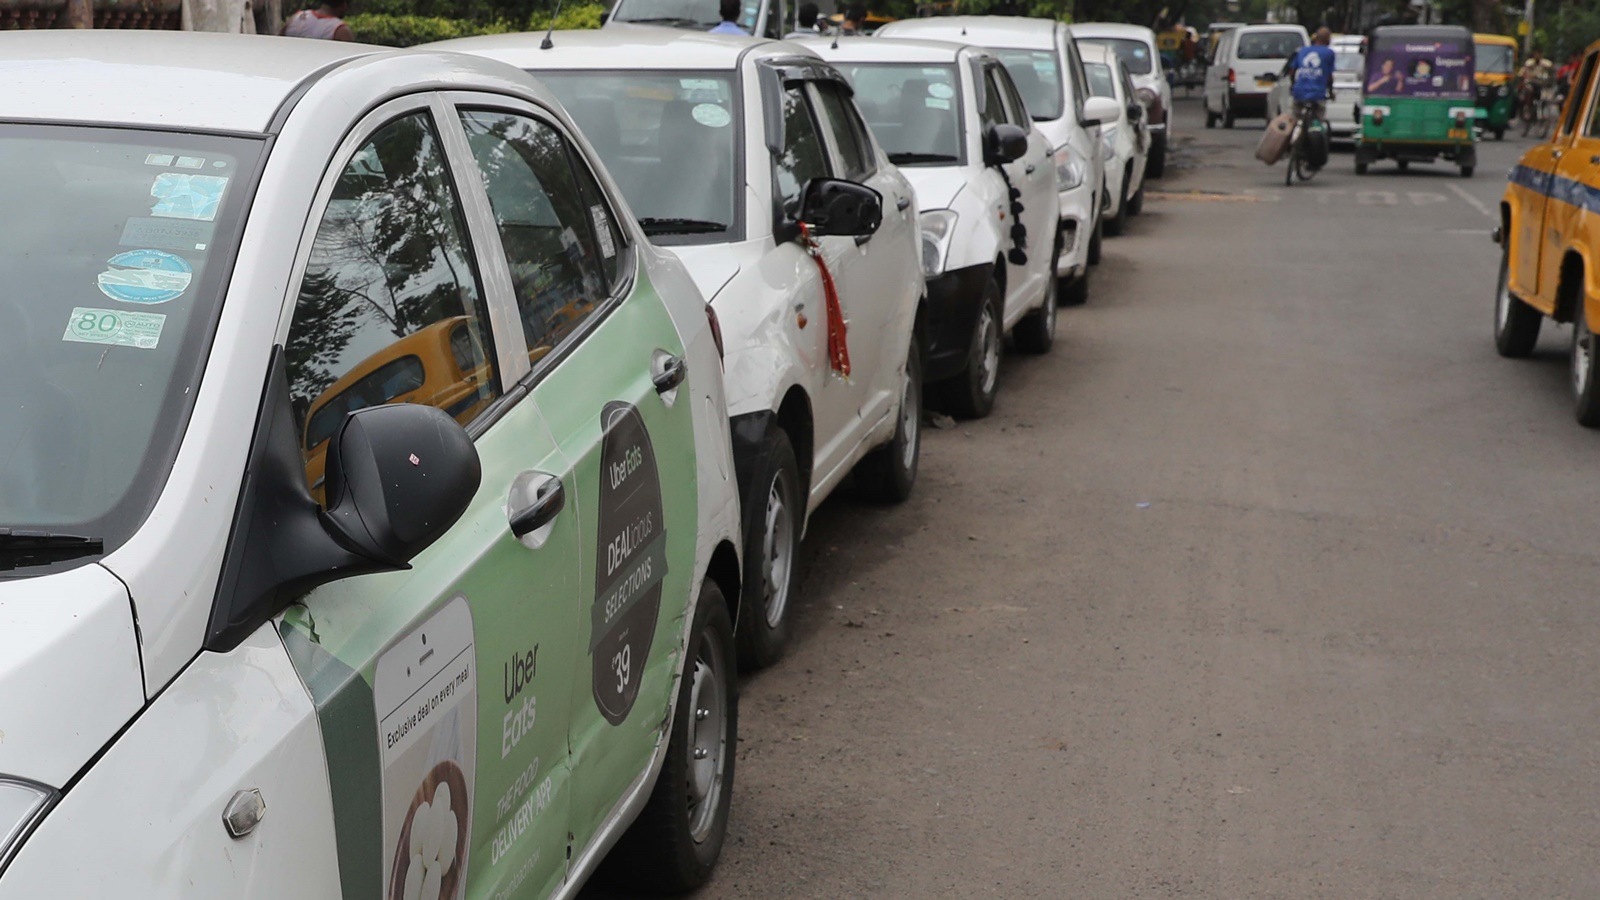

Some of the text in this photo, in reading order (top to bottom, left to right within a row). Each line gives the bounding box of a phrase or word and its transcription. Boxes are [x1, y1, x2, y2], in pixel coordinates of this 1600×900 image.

[78, 313, 117, 332] 80
[609, 444, 643, 490] Uber Eats
[604, 556, 652, 624] SELECTIONS
[387, 663, 470, 750] Exclusive deal on every meal
[504, 642, 539, 705] Uber
[501, 695, 537, 760] Eats
[491, 776, 552, 867] DELIVERY APP
[496, 756, 539, 824] THE FOOD
